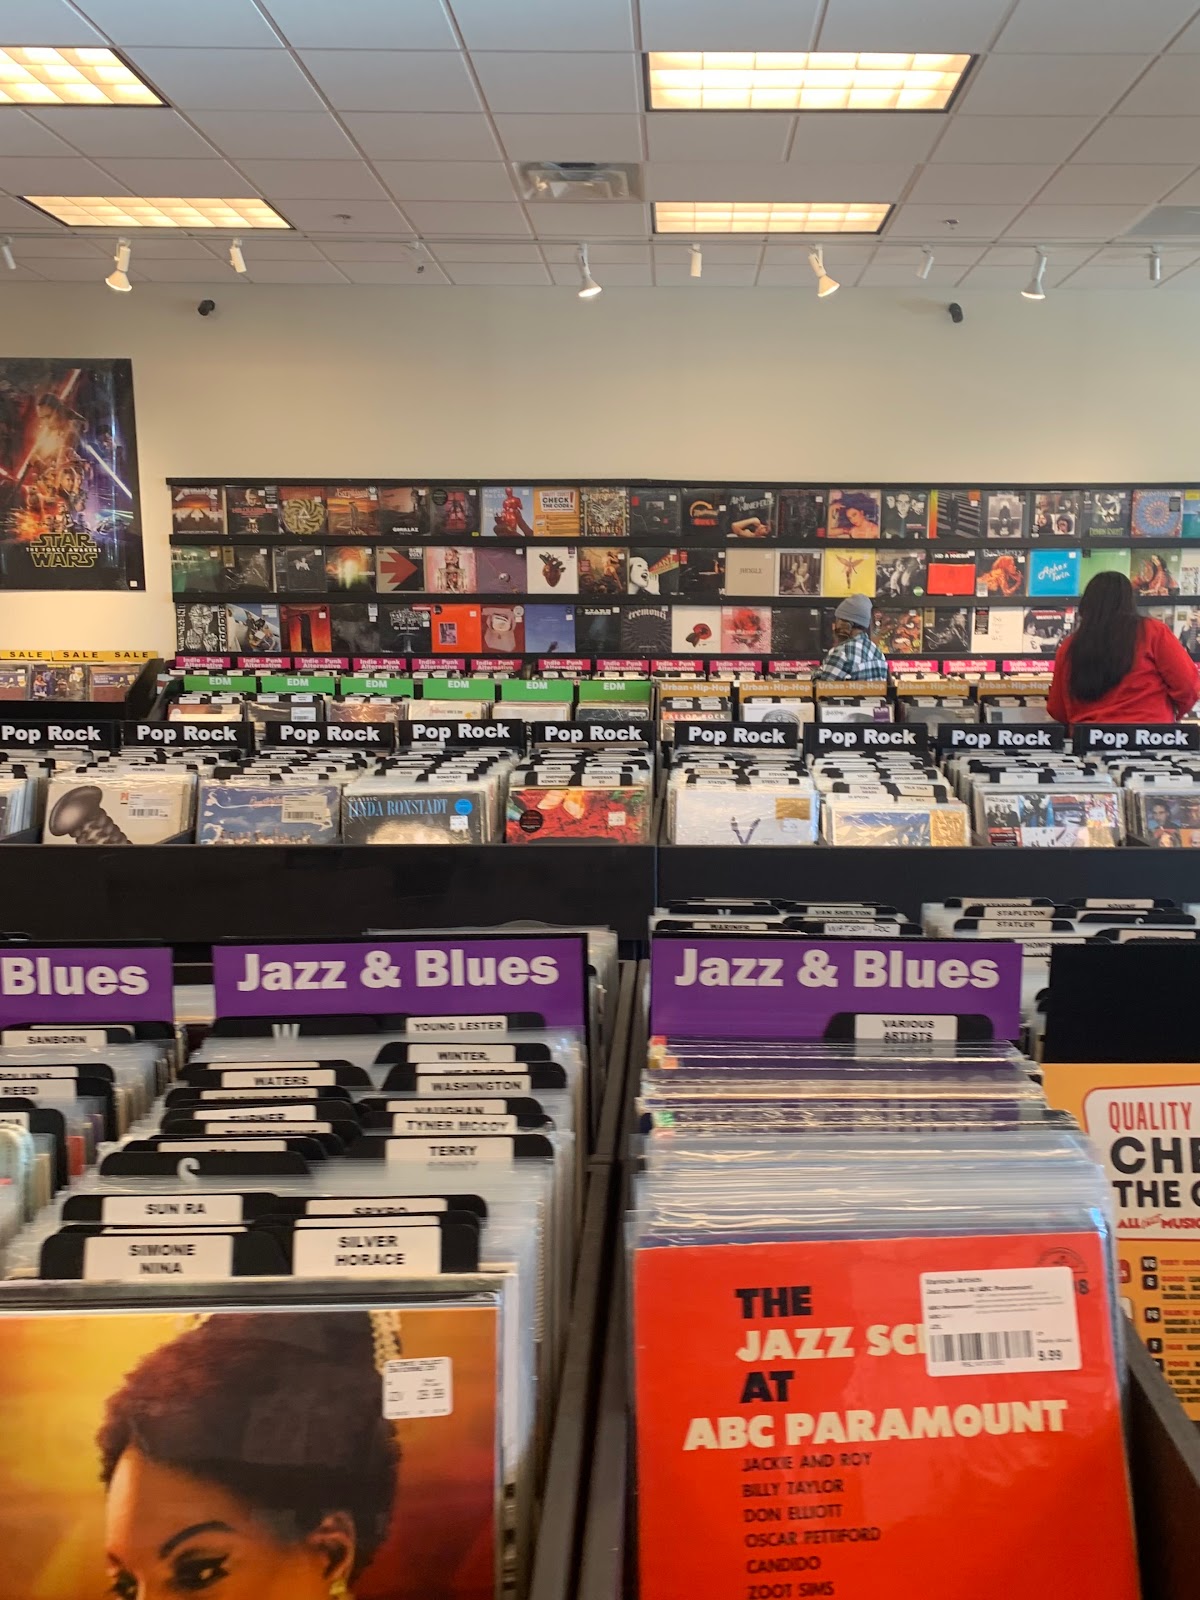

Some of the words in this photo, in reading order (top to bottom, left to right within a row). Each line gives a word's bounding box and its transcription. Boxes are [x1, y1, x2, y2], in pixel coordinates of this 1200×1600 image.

[30, 532, 97, 547] STAR
[30, 552, 98, 568] WARS
[209, 677, 232, 685] EDM
[287, 678, 309, 686] EDM
[366, 680, 388, 688] EDM
[448, 680, 470, 688] EDM
[526, 682, 548, 690] EDM
[604, 682, 626, 690] EDM
[1, 726, 41, 744] Pop
[48, 726, 101, 740] Rock
[137, 726, 176, 744] Pop
[184, 726, 237, 741] Rock
[280, 726, 320, 744] Pop
[327, 726, 380, 741] Rock
[412, 724, 450, 741] Pop
[458, 723, 510, 738] Rock
[545, 726, 584, 744] Pop
[590, 725, 642, 741] Rock
[688, 726, 727, 746] Pop
[734, 726, 786, 744] Rock
[819, 729, 857, 747] Pop
[864, 729, 916, 744] Rock
[952, 730, 991, 748] Pop
[998, 730, 1051, 746] Rock
[1090, 729, 1129, 748] Pop
[1136, 729, 1188, 745] Rock
[348, 800, 384, 818] LINDA
[387, 798, 448, 816] RONSTADT
[1, 956, 150, 996] Blues
[237, 953, 348, 992] Jazz
[360, 949, 402, 989] &
[416, 948, 560, 988] Blues
[674, 948, 784, 987] Jazz
[797, 949, 838, 988] &
[854, 949, 1000, 989] Blues
[414, 1023, 456, 1031] YOUNG
[458, 1022, 504, 1030] LESTER
[882, 1020, 935, 1028] VARIOUS
[27, 1036, 87, 1044] SANBORN
[884, 1032, 933, 1044] ARTISTS
[254, 1076, 310, 1086] WATERS
[431, 1082, 522, 1091] WASHINGTON
[2, 1086, 38, 1095] REED
[406, 1120, 453, 1130] TYNER
[1108, 1102, 1192, 1131] QUALITY
[428, 1146, 478, 1156] TERRY
[1112, 1179, 1182, 1208] THE
[145, 1203, 180, 1214] SUN
[184, 1203, 207, 1214] RA
[1118, 1218, 1141, 1229] ALL
[128, 1244, 196, 1256] SIMONE
[338, 1236, 398, 1248] SILVER
[140, 1262, 183, 1274] NINA
[334, 1253, 406, 1266] HORACE
[735, 1286, 812, 1319] THE
[735, 1326, 855, 1362] JAZZ
[740, 1370, 794, 1404] AT
[682, 1414, 774, 1451] ABC
[785, 1400, 1068, 1446] PARAMOUNT
[742, 1456, 793, 1472] JACKIE
[801, 1454, 834, 1468] AND
[840, 1452, 872, 1466] ROY
[742, 1482, 780, 1498] BILLY
[786, 1479, 844, 1494] TAYLOR
[744, 1508, 782, 1523] DON
[787, 1504, 843, 1520] ELLIOTT
[744, 1531, 798, 1548] OSCAR
[804, 1526, 881, 1544] PETTIFORD
[746, 1556, 822, 1574] CANDIDO
[747, 1583, 792, 1600] ZOOT
[798, 1581, 835, 1597] SIMS
